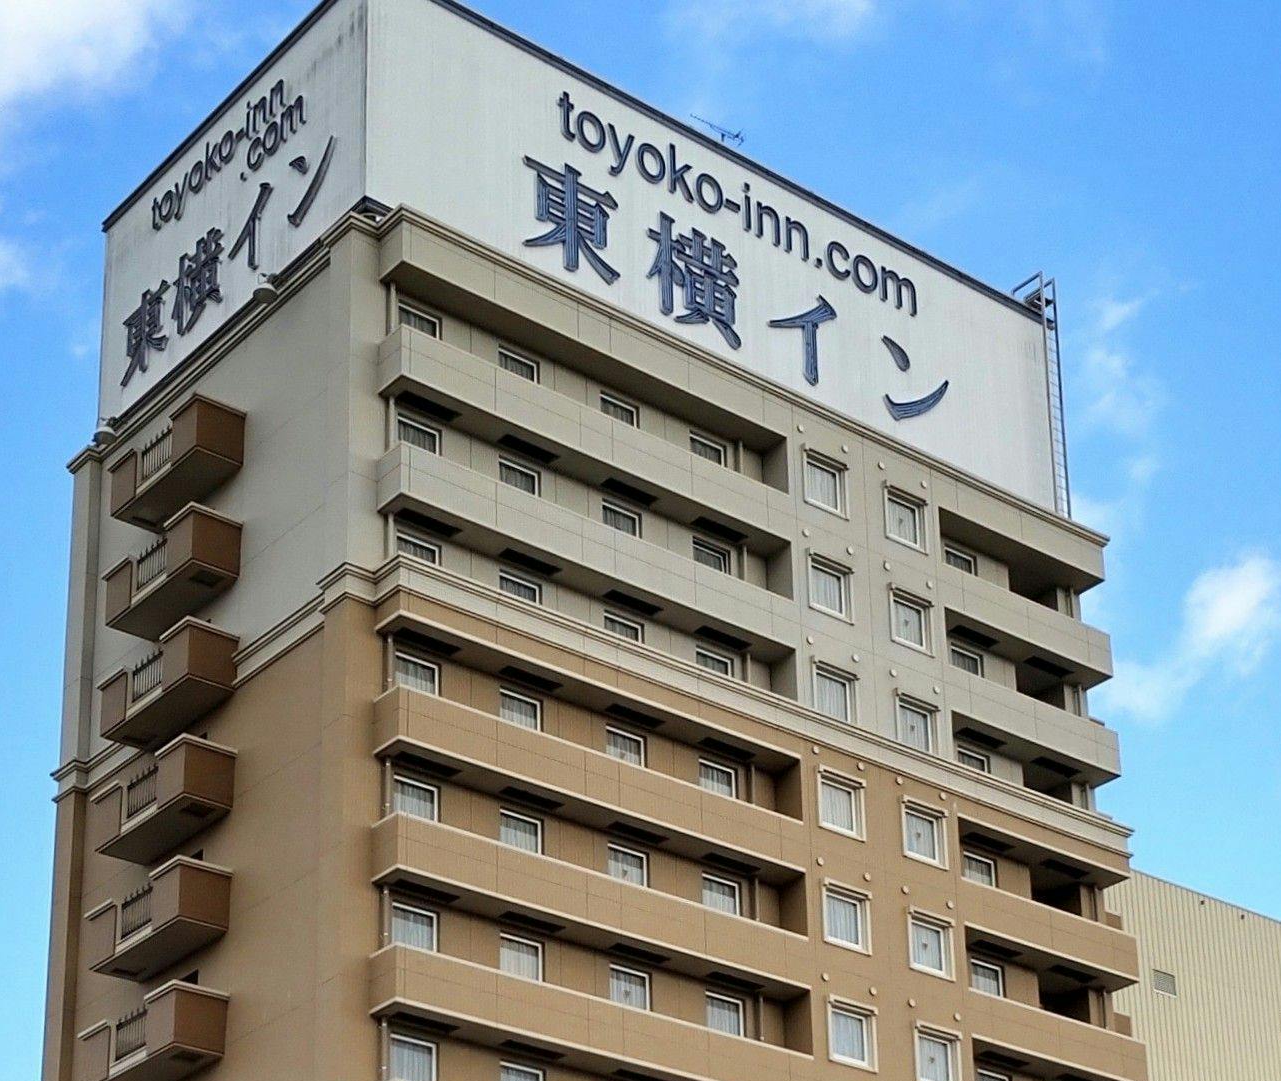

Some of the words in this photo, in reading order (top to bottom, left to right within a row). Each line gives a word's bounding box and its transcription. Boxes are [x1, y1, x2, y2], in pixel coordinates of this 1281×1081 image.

[151, 78, 286, 231] toyoko-inn
[239, 94, 307, 182] .com
[557, 90, 918, 317] toyoko-inn.com
[120, 134, 338, 387] 東横イン
[522, 154, 950, 421] 東横イン
